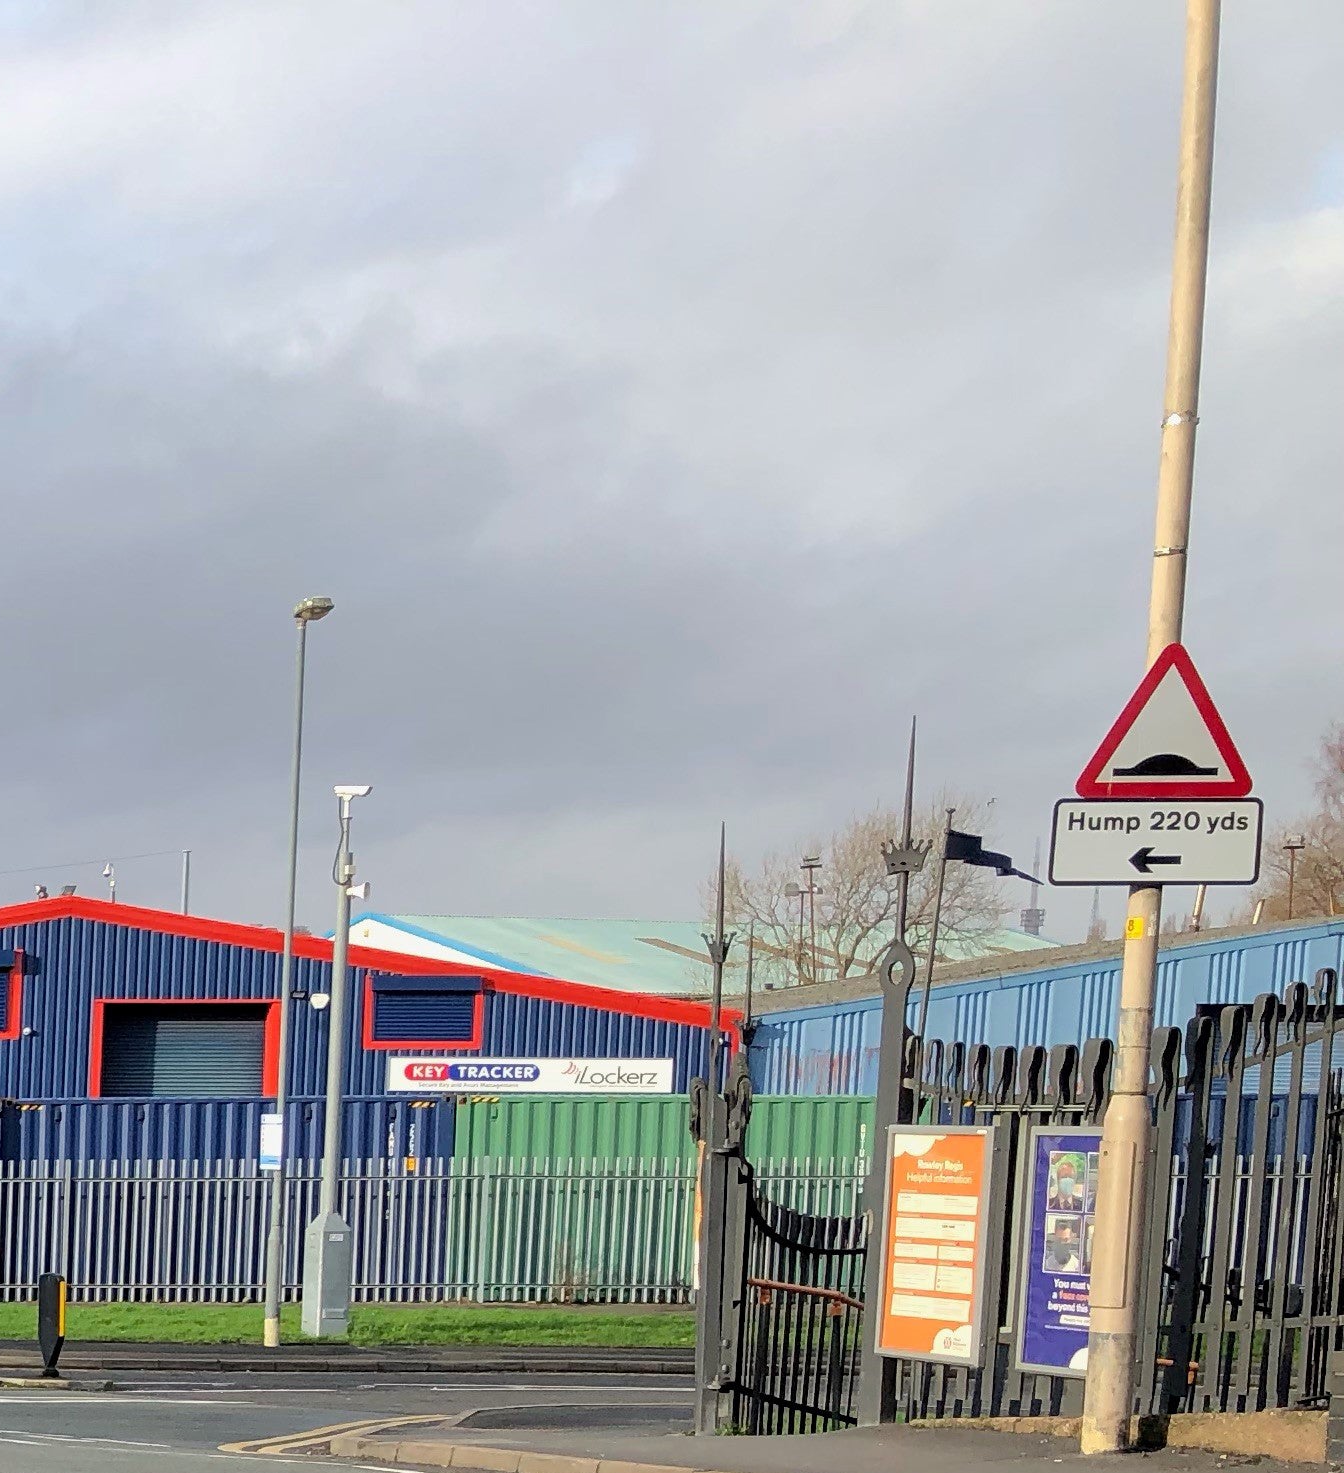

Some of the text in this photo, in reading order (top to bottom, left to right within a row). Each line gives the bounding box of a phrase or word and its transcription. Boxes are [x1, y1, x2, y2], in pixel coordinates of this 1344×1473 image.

[1067, 811, 1249, 835] Hump 220 yds
[412, 1066, 534, 1079] KEY TRACKER
[574, 1065, 658, 1085] iLockerz
[944, 1160, 964, 1172] Regis
[1054, 1278, 1070, 1289] You
[1052, 1291, 1058, 1300] a
[1047, 1300, 1089, 1313] beyond this
